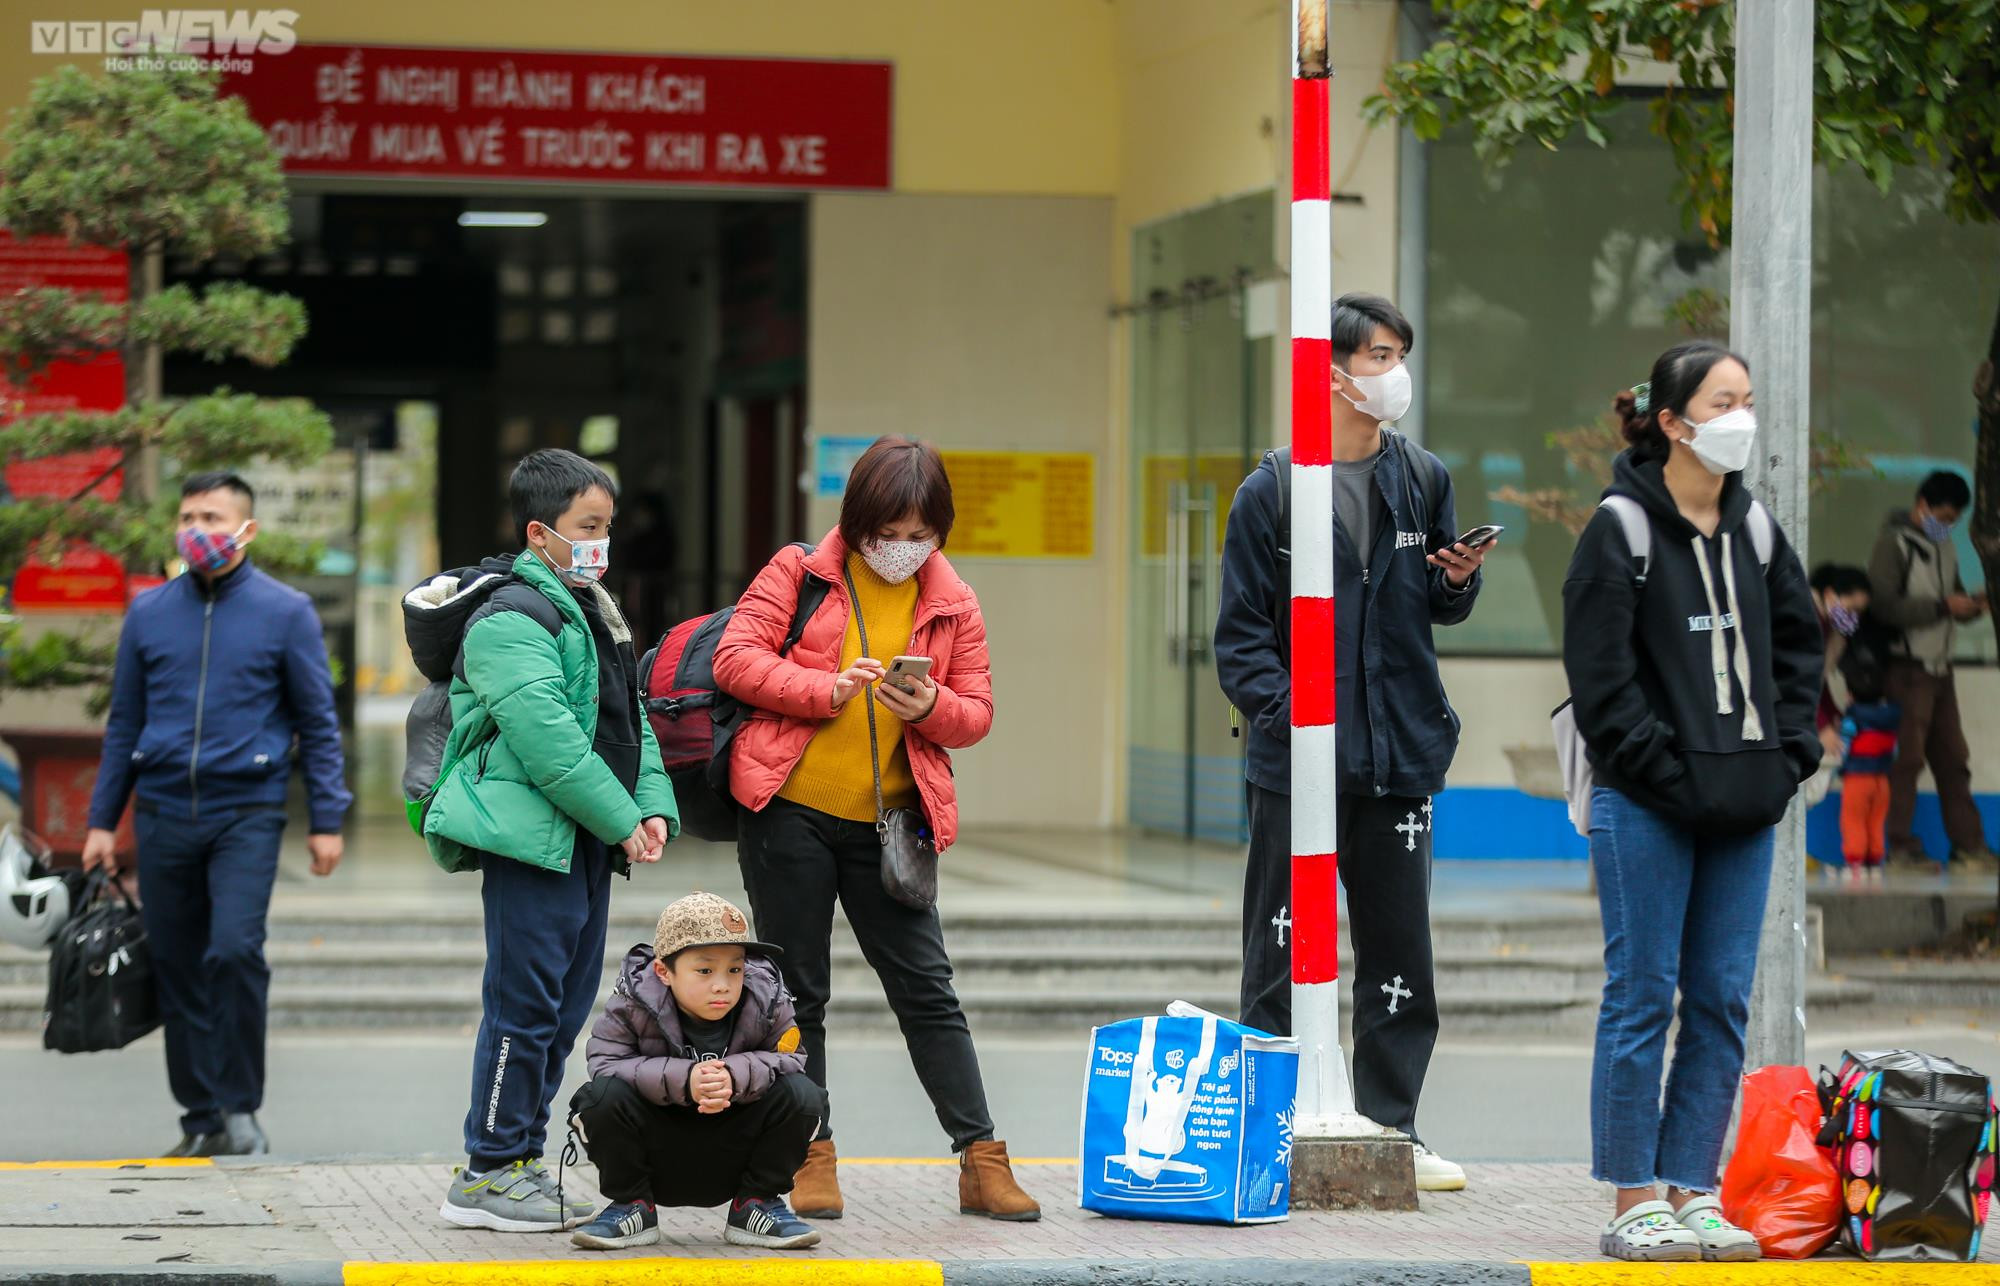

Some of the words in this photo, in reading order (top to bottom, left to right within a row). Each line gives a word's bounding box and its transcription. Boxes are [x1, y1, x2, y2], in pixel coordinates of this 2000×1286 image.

[471, 60, 572, 110] HÀNH
[586, 65, 705, 114] KHÁCH
[370, 121, 446, 163] MUA
[454, 116, 505, 166] VÉ
[645, 131, 706, 172] KHI
[715, 133, 768, 173] RA
[778, 135, 828, 176] XE
[1098, 1046, 1134, 1067] Tops
[1219, 1050, 1239, 1078] go!
[1095, 1067, 1131, 1078] market
[1201, 1082, 1216, 1092] Tôi
[1192, 1115, 1209, 1126] của
[1210, 1116, 1228, 1128] bạn
[1196, 1141, 1222, 1151] ngon
